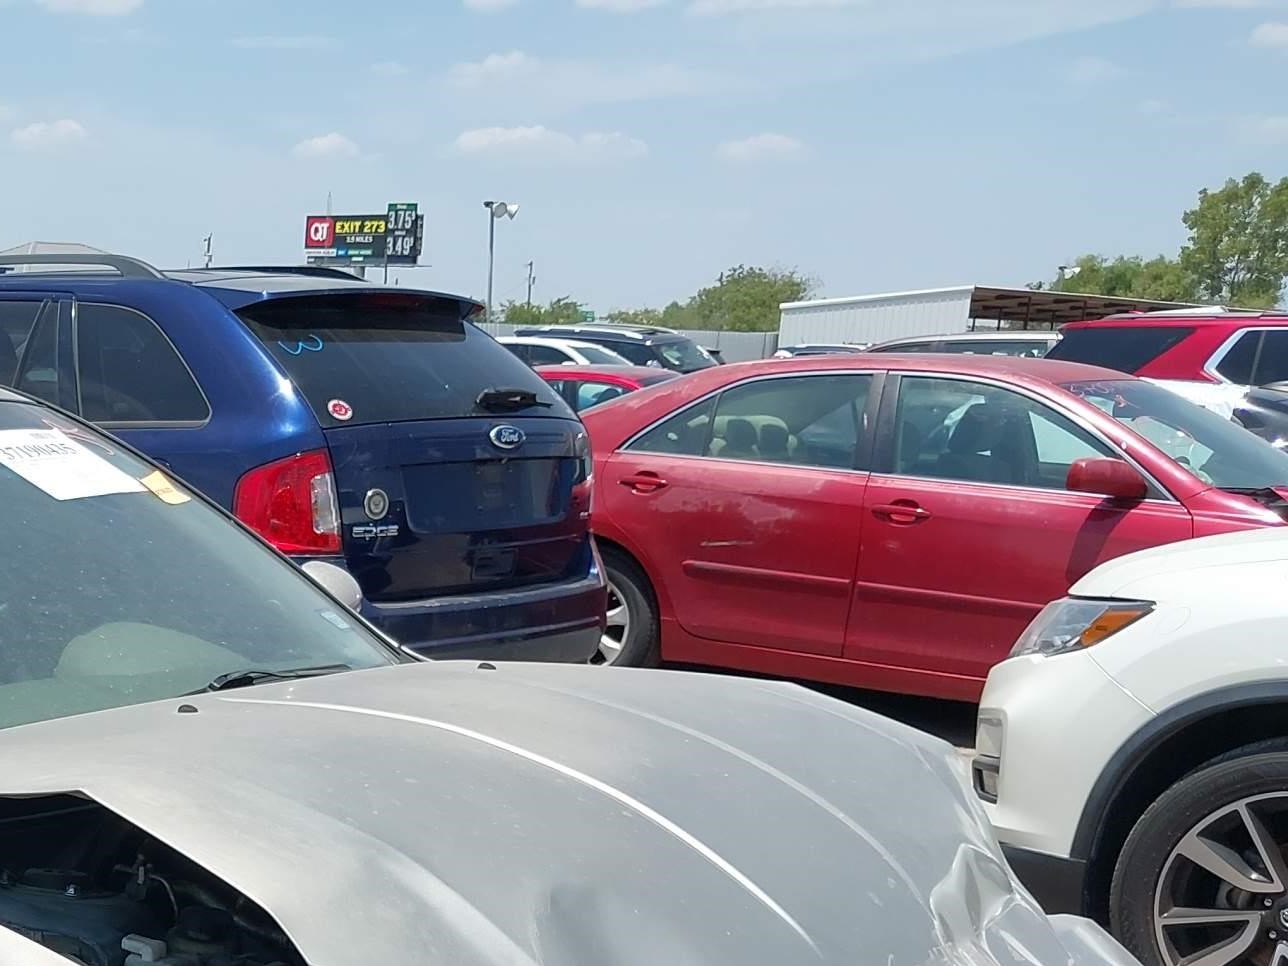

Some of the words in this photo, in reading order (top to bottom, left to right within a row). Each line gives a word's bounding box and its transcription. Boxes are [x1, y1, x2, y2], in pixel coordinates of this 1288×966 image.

[310, 222, 329, 241] QT
[335, 221, 362, 233] EXIT
[363, 220, 386, 233] 273
[352, 525, 399, 538] EDGE
